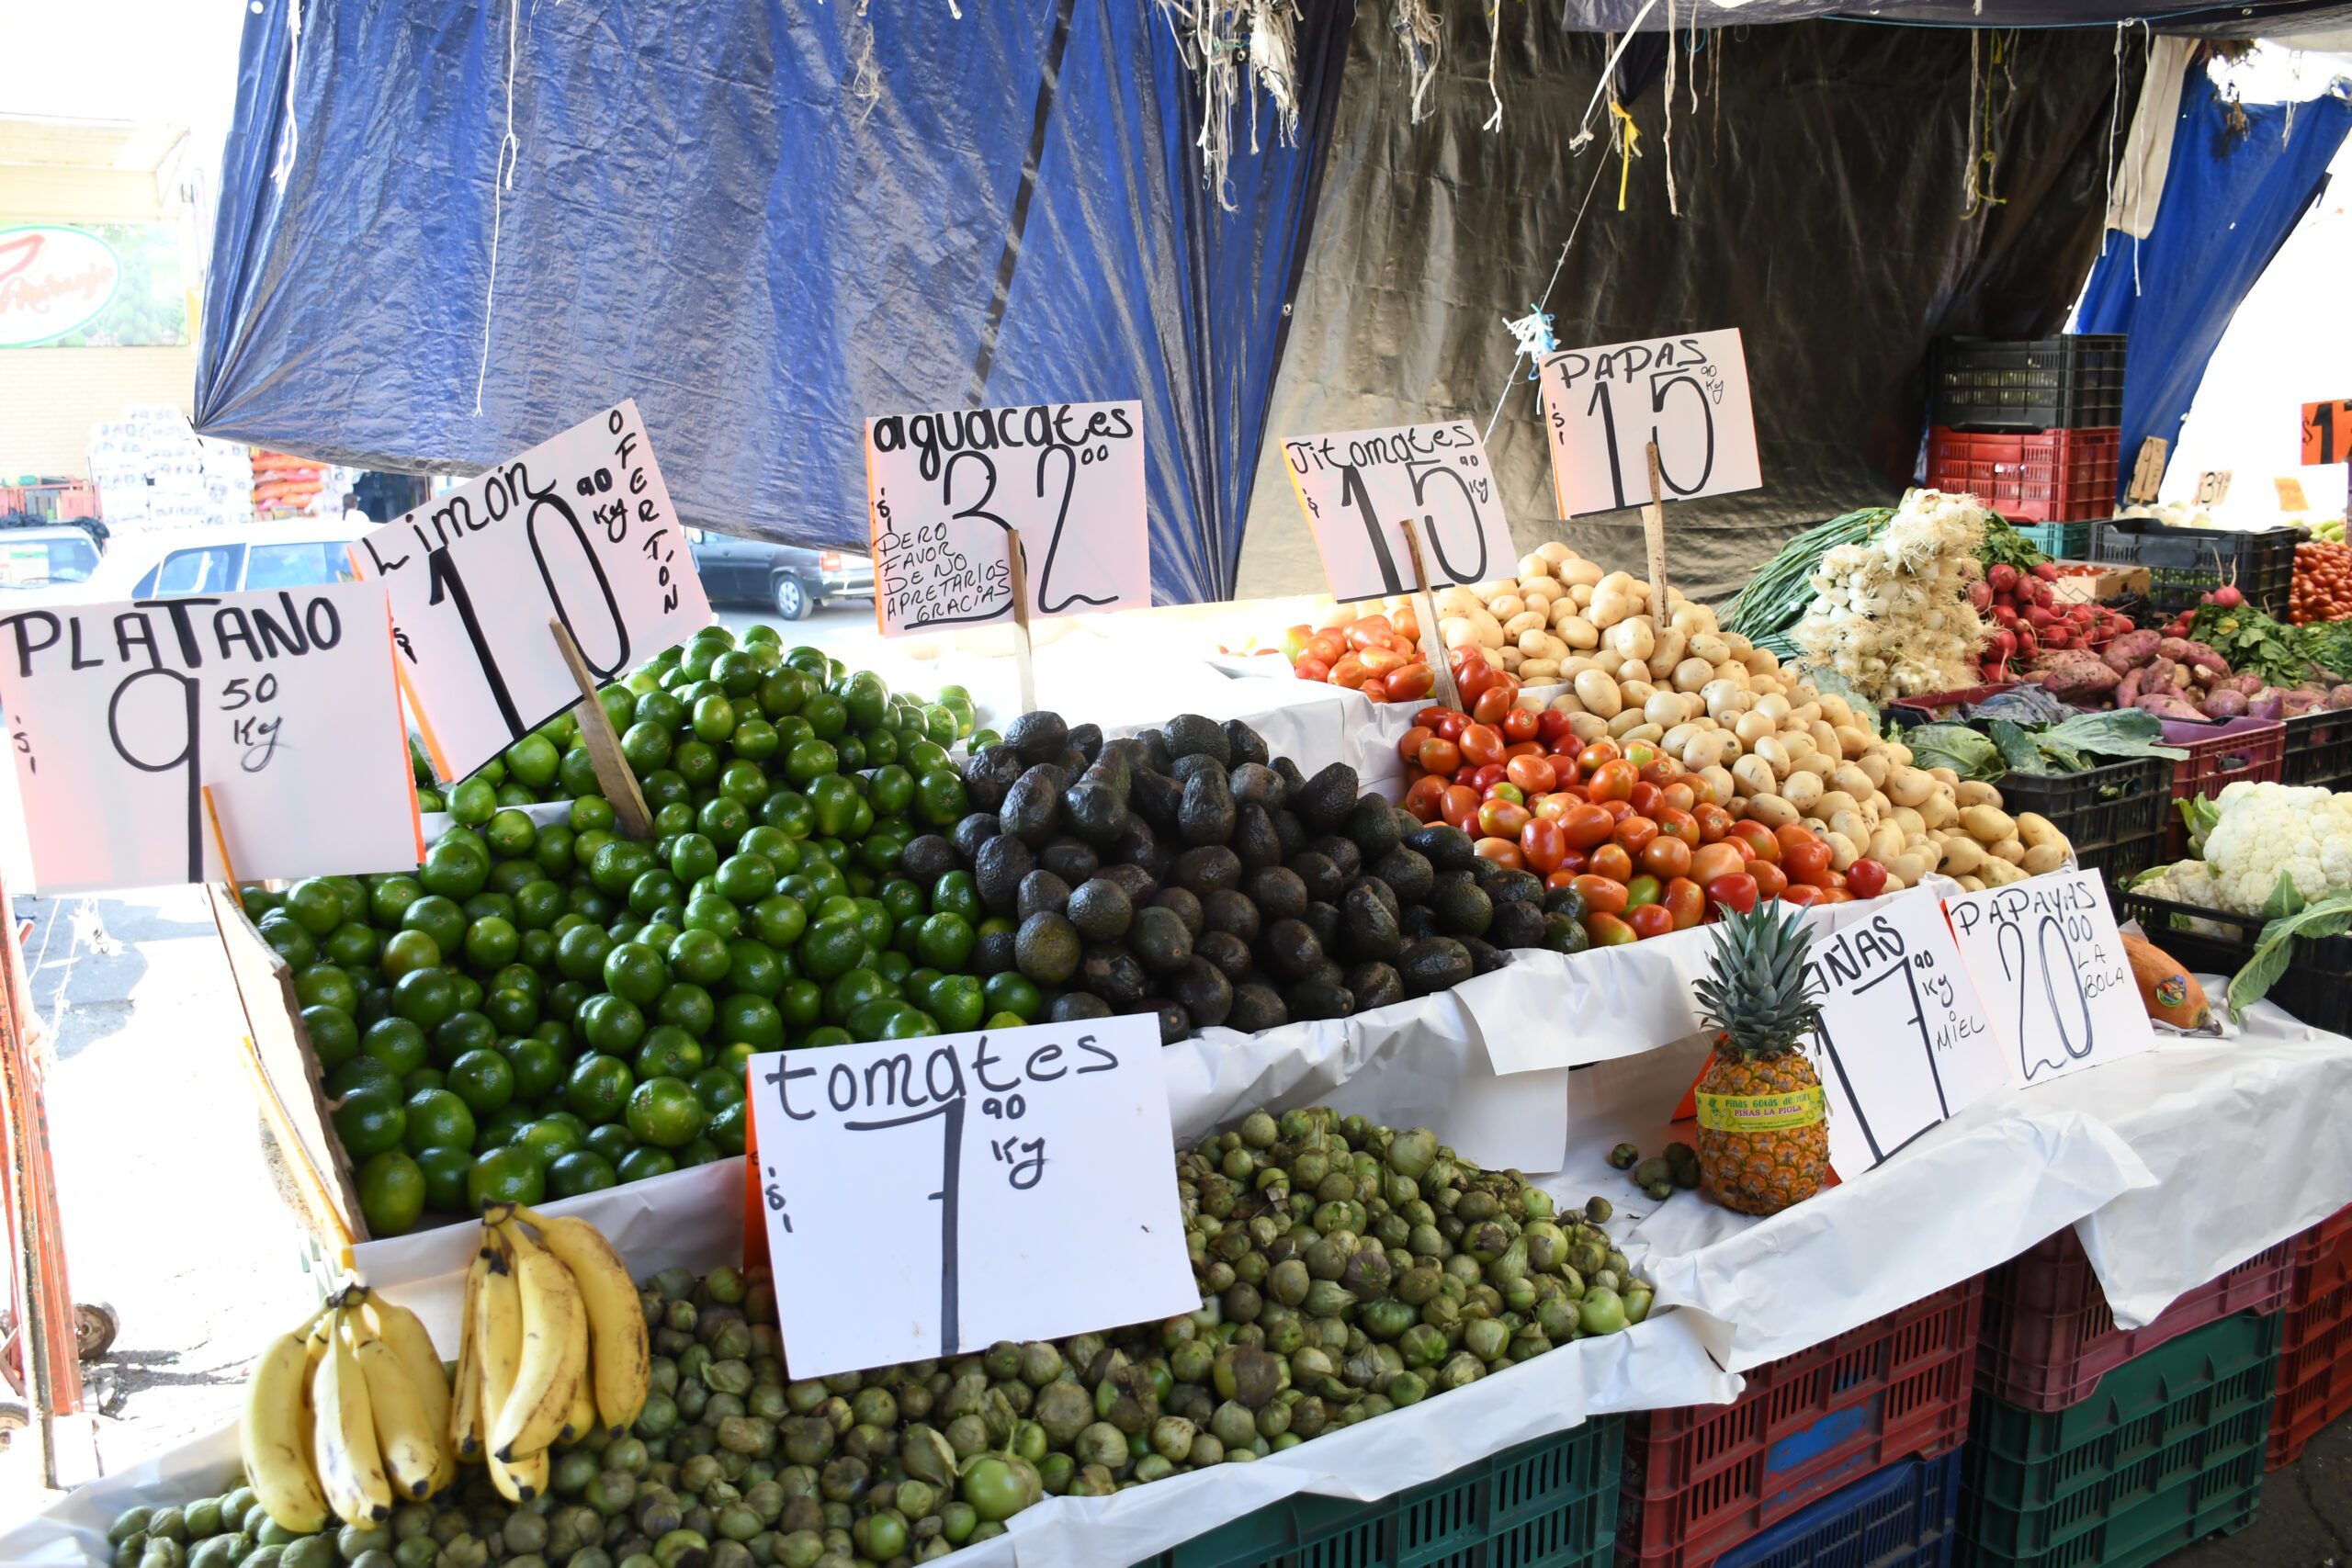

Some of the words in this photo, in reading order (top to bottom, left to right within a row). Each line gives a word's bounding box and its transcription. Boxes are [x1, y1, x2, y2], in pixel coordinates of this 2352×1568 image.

[1544, 340, 1707, 389] PAPAS
[874, 405, 1133, 480] aguacates
[1286, 425, 1475, 474] Jitomates
[1570, 368, 1713, 518] 15
[879, 542, 956, 577] FAVOR
[904, 444, 1119, 630] 32
[1337, 459, 1487, 604] 15
[885, 571, 924, 596] DE
[934, 554, 967, 579] NO
[0, 592, 342, 678] PLATANO
[429, 494, 630, 784] 10
[108, 668, 204, 883] 9
[220, 672, 277, 711] 50
[1951, 881, 2096, 936] PAPAYAS
[1814, 915, 1905, 993] IÑAS
[2078, 943, 2106, 969] LA
[2084, 966, 2124, 999] BOLA
[1997, 916, 2094, 1080] 20
[2068, 914, 2093, 942] 00
[764, 1035, 1119, 1121] tomates
[1812, 955, 1949, 1168] 17
[1734, 1109, 1761, 1117] PIÑAS
[1764, 1108, 1775, 1116] LA
[1779, 1105, 1802, 1114] PIOLA
[844, 1095, 966, 1356] 7
